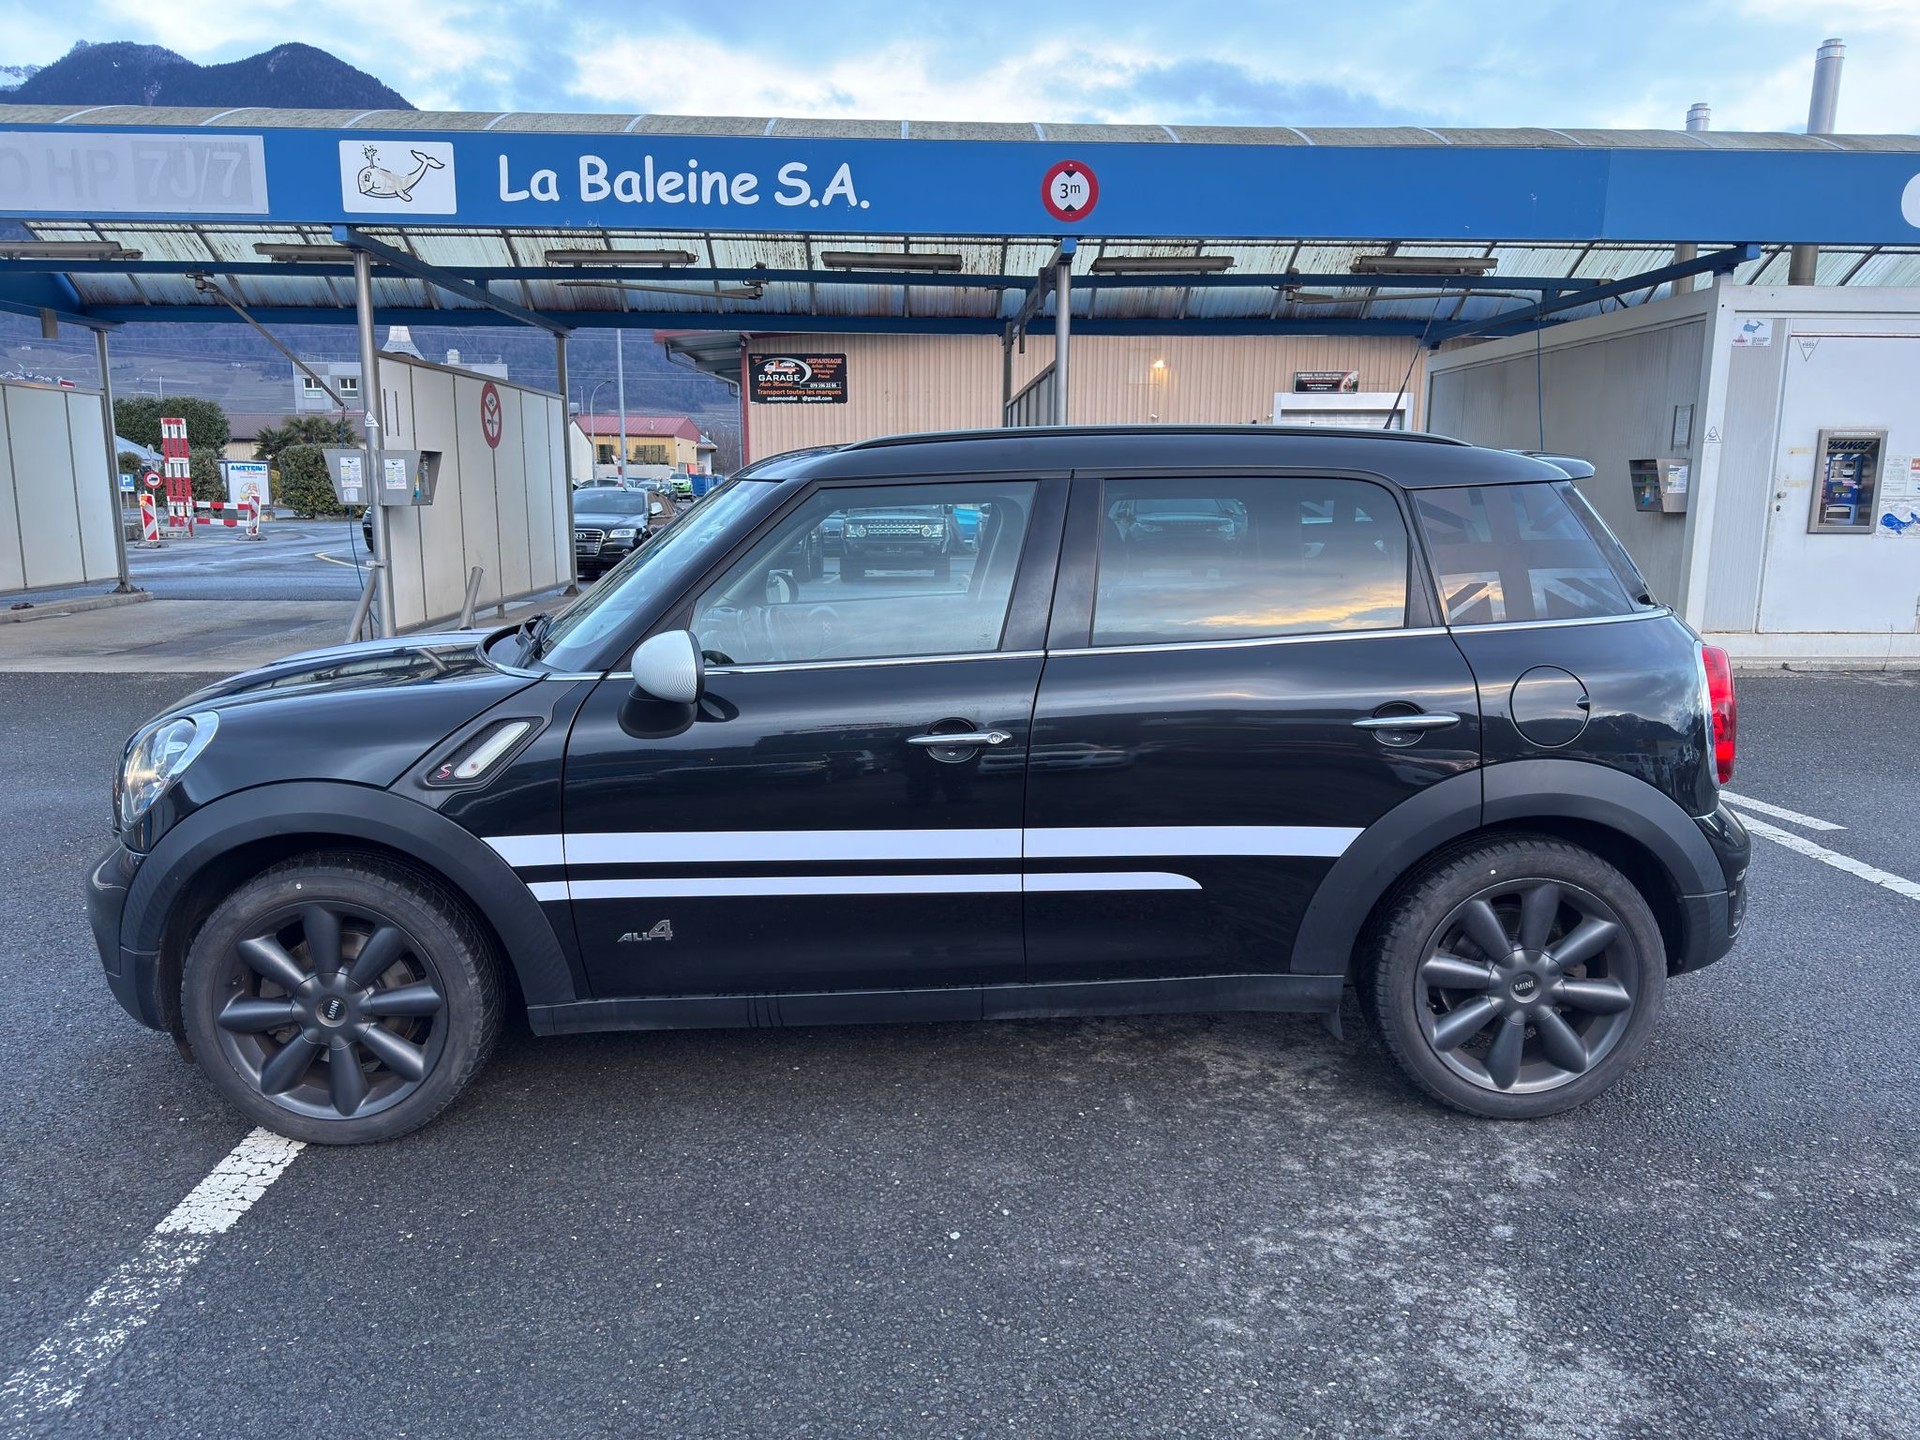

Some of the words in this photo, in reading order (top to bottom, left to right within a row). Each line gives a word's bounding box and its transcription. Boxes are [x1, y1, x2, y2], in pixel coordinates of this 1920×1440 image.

[47, 148, 119, 200] HP
[139, 148, 243, 199] 7J/7
[499, 154, 560, 202] La
[578, 154, 760, 205] Baleine
[774, 162, 870, 208] S.A.
[758, 374, 800, 382] GARAGE
[122, 475, 130, 485] P
[436, 763, 452, 779] S
[617, 919, 673, 942] ALL4
[1514, 980, 1534, 991] MINI
[327, 1000, 340, 1019] MINI
